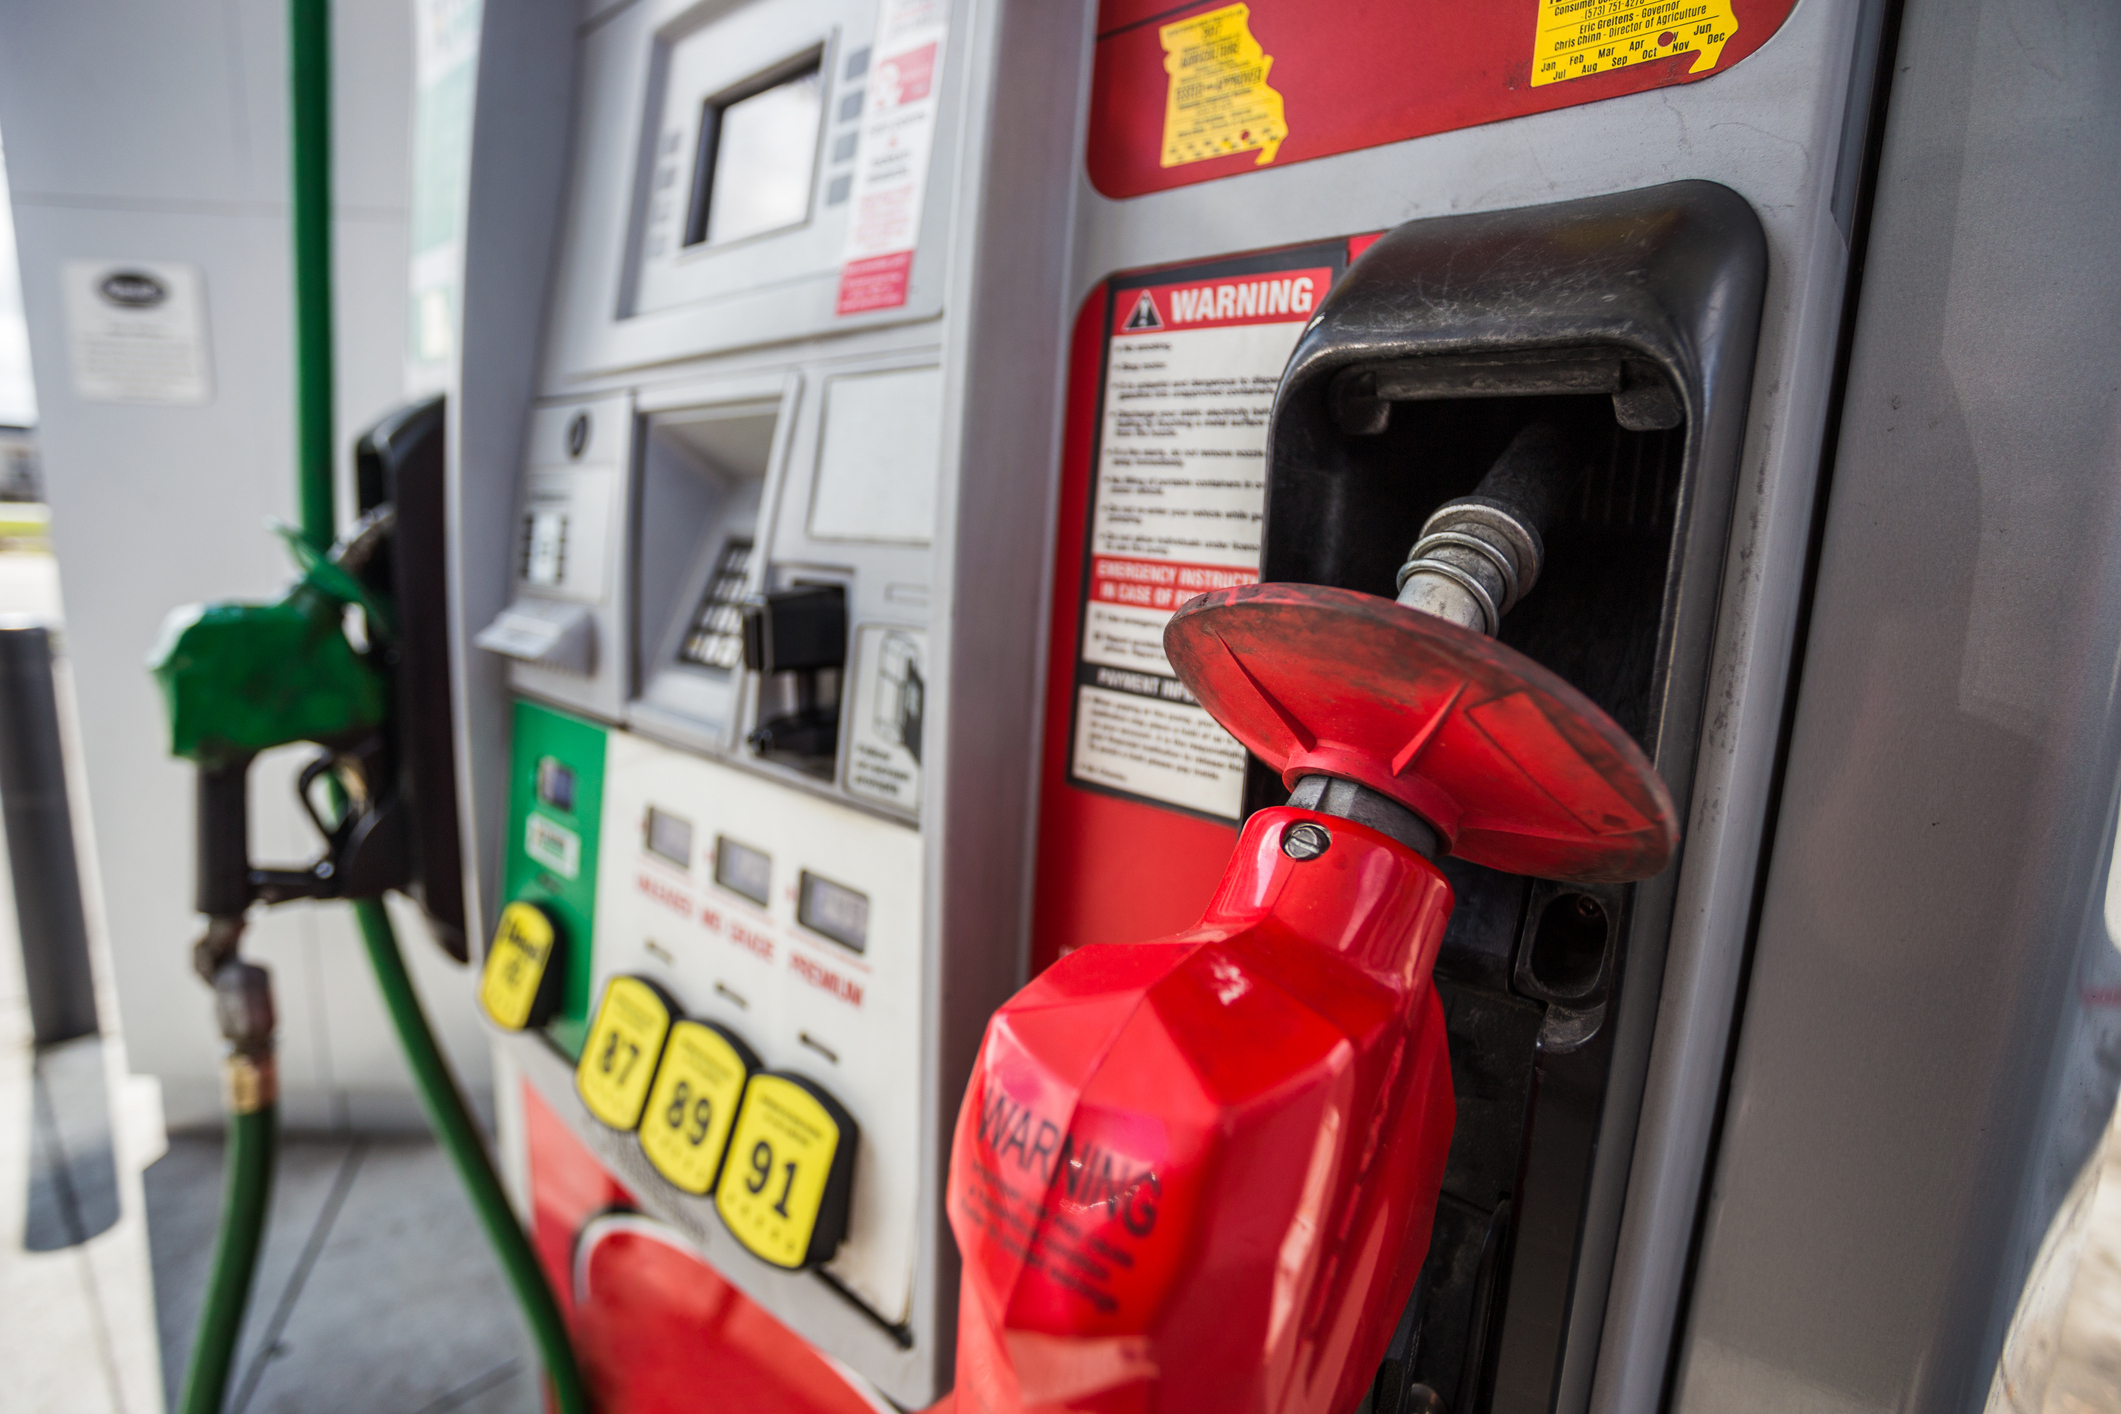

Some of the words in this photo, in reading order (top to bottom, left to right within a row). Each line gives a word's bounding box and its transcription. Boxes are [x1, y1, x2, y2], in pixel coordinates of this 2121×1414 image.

[1554, 38, 1576, 51] Chris
[1578, 32, 1602, 46] Chinn
[1608, 21, 1642, 38] Director
[1645, 18, 1654, 28] of
[1656, 4, 1706, 26] Agriculture
[1580, 22, 1596, 34] Eric
[1598, 12, 1634, 30] Greitens
[1642, 0, 1680, 18] Governor
[1540, 60, 1556, 72] Jan
[1569, 53, 1584, 66] Feb
[1598, 47, 1614, 59] Mar
[1629, 39, 1645, 52] Apr
[1694, 23, 1712, 36] Jun
[1553, 68, 1566, 80] Jul
[1582, 62, 1598, 74] Aug
[1612, 55, 1628, 67] Sep
[1642, 48, 1657, 60] Oct
[1672, 41, 1690, 52] Nov
[1707, 32, 1725, 44] Dec
[1170, 276, 1314, 324] WARNING
[1096, 559, 1177, 585] EMERGENCY
[1102, 580, 1116, 599] IN
[1118, 582, 1150, 604] CASE
[1154, 587, 1174, 607] OF
[1097, 667, 1160, 697] PAYMENT
[788, 951, 864, 1008] PREMIUM
[601, 1030, 641, 1089] 87
[665, 1080, 712, 1147] 89
[745, 1140, 798, 1220] 91
[978, 1085, 1162, 1239] WARNING
